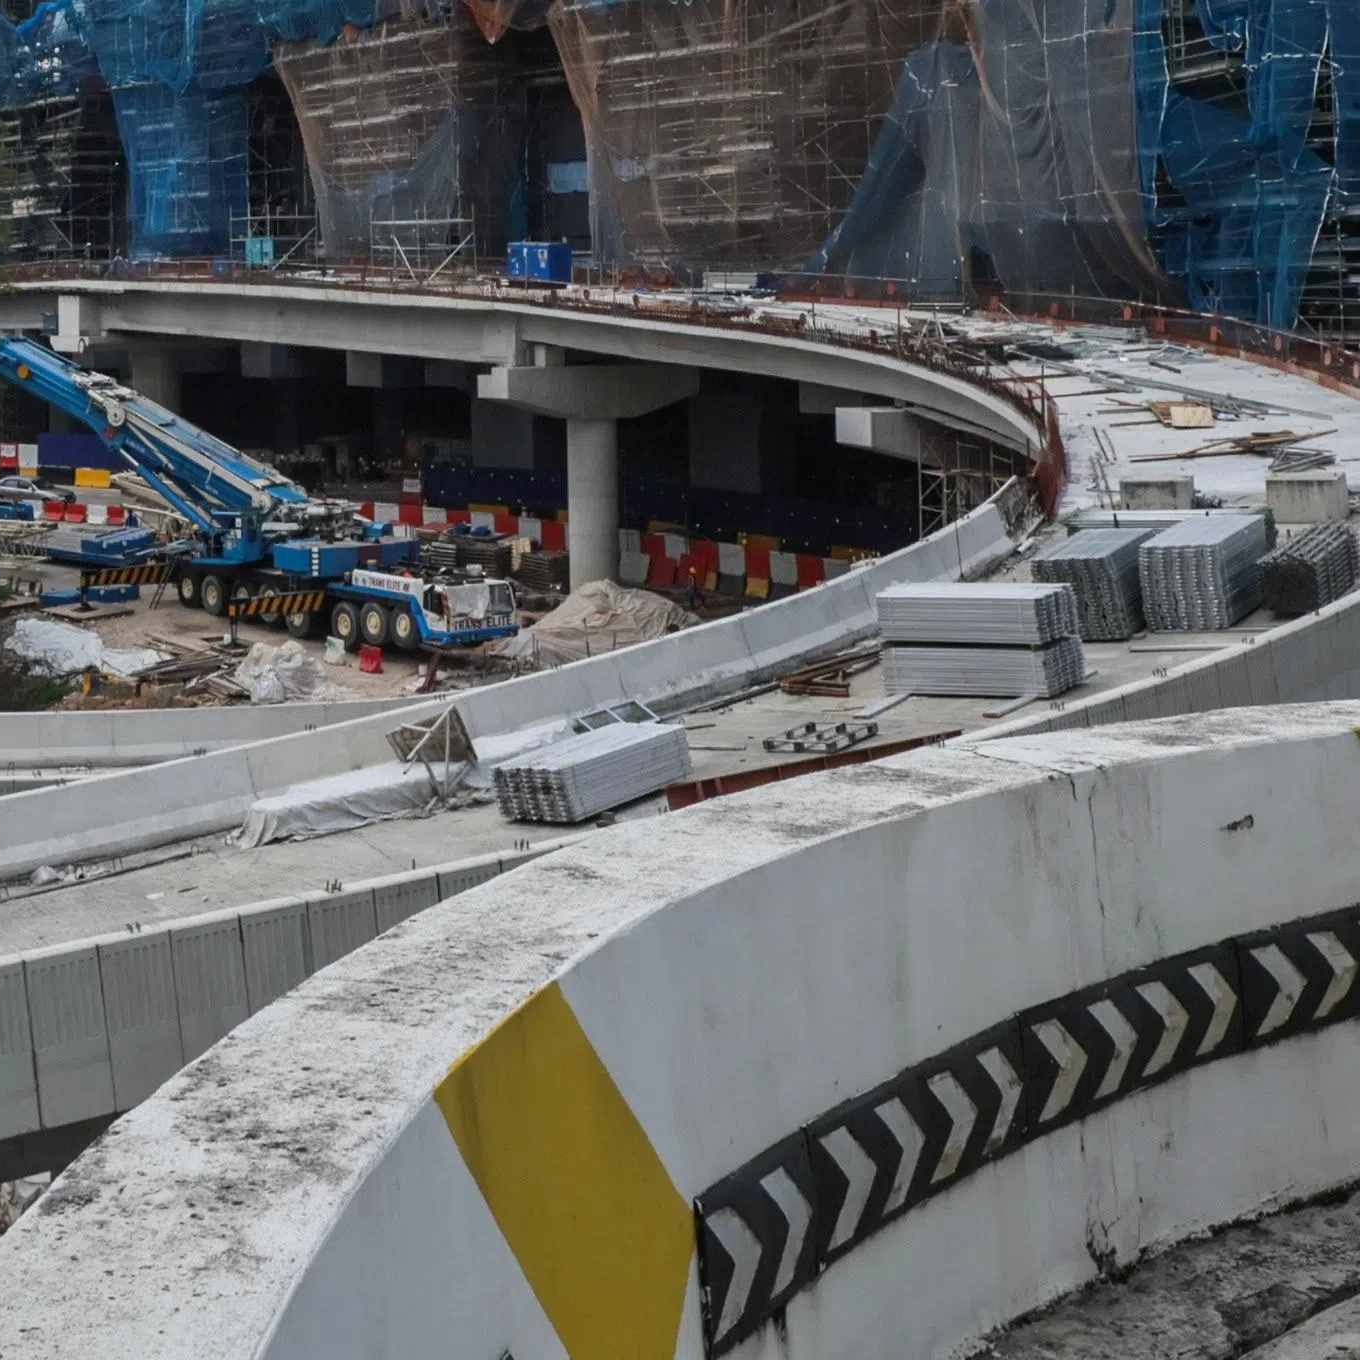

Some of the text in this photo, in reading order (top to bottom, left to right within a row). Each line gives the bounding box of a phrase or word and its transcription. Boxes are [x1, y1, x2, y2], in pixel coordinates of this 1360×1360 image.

[369, 576, 385, 588] TRANS
[386, 579, 402, 591] ELITE
[453, 614, 513, 631] TRANS ELITE
